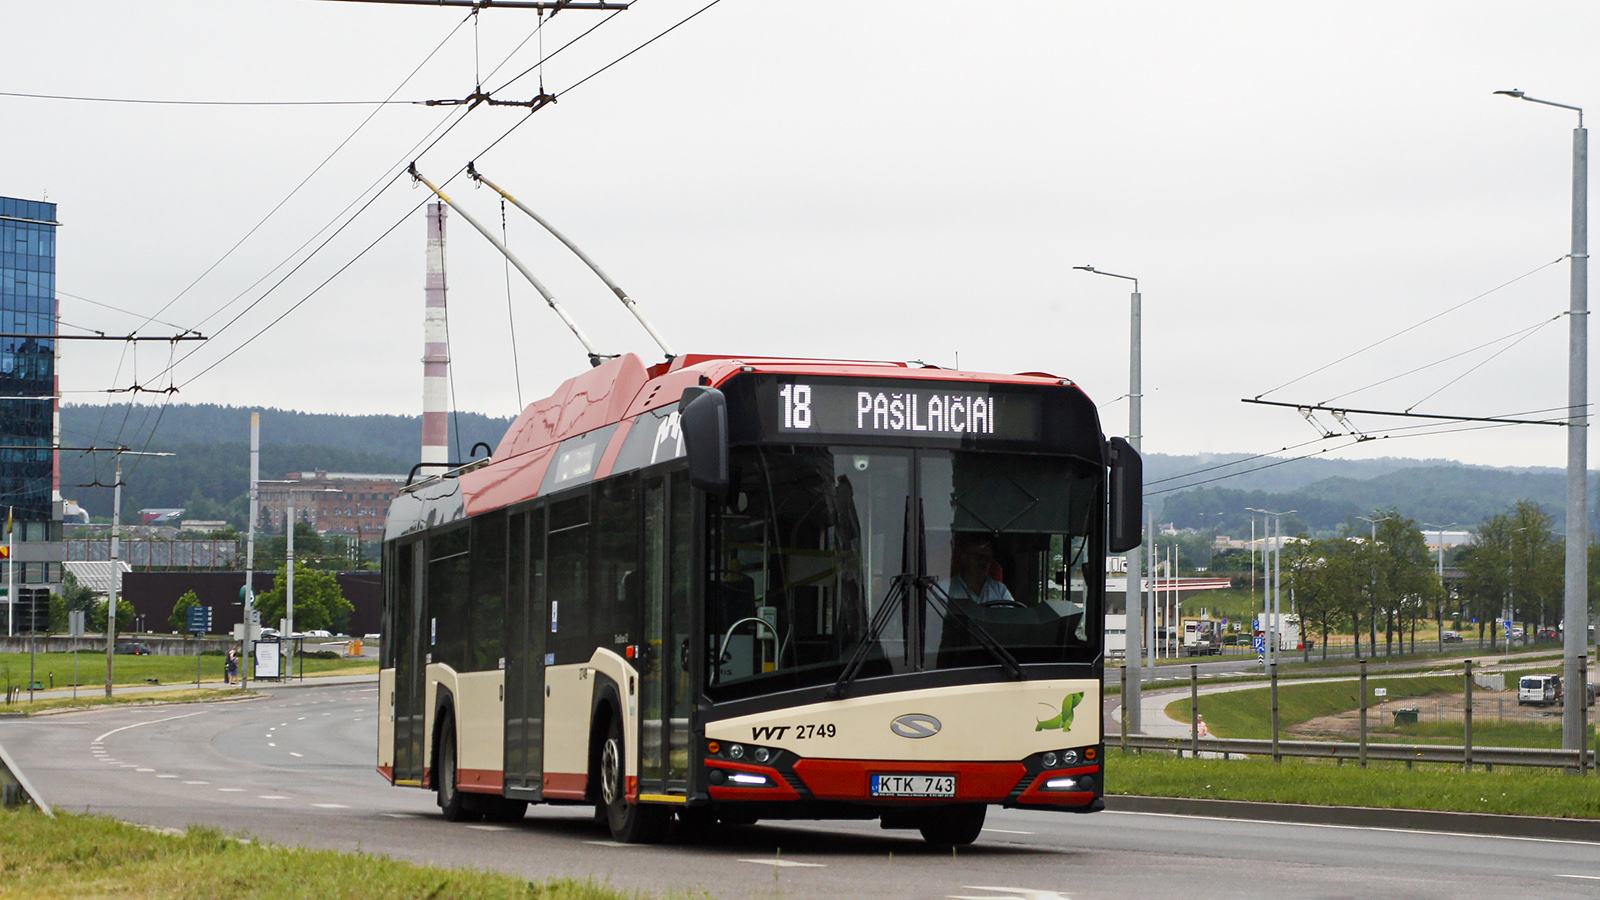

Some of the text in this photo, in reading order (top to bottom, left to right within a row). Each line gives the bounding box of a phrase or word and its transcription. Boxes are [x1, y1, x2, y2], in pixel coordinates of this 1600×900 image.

[780, 384, 994, 434] 18 PAŠILAIČIAI
[752, 723, 836, 740] VVT 2749
[880, 777, 953, 792] KTK 743
